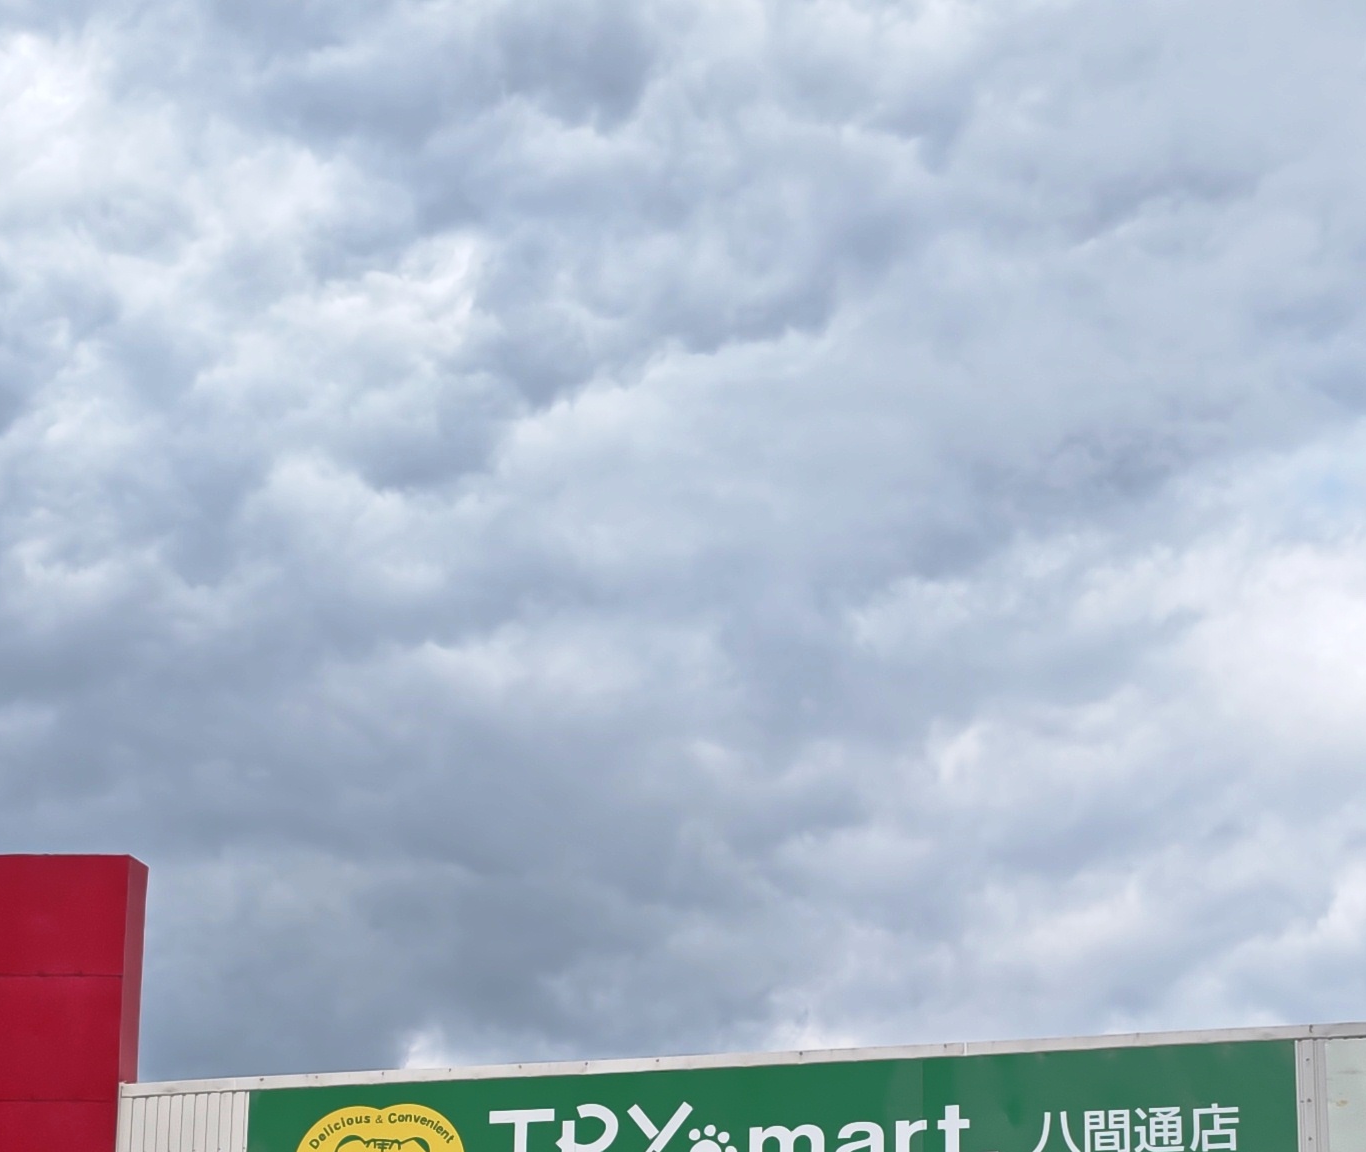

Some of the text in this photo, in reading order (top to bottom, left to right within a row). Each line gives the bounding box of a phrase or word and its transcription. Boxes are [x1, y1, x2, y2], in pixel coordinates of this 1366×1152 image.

[308, 1112, 455, 1150] Delicious & Convenient
